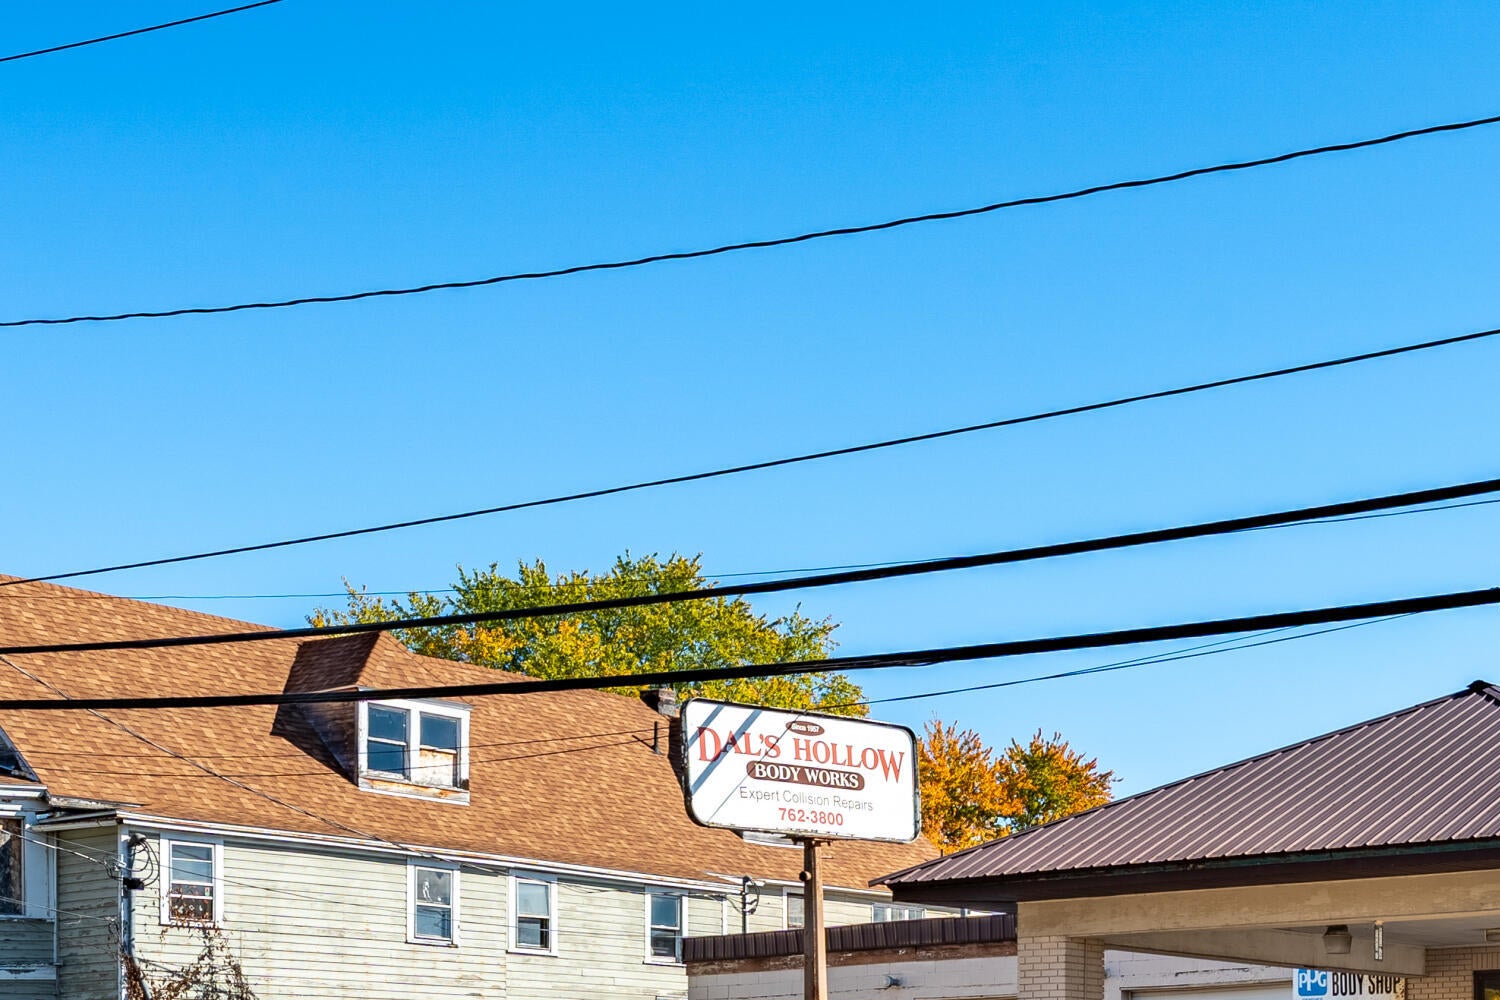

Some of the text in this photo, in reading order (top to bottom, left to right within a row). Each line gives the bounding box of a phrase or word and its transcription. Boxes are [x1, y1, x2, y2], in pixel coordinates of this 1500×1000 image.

[697, 726, 905, 784] DAL'S HOLLOW
[754, 763, 859, 789] BODY WORKS
[739, 786, 874, 812] Expert Collision Repairs
[778, 808, 844, 826] 762-3800
[1299, 969, 1327, 991] PPG
[1332, 972, 1400, 996] BODY SHOP
